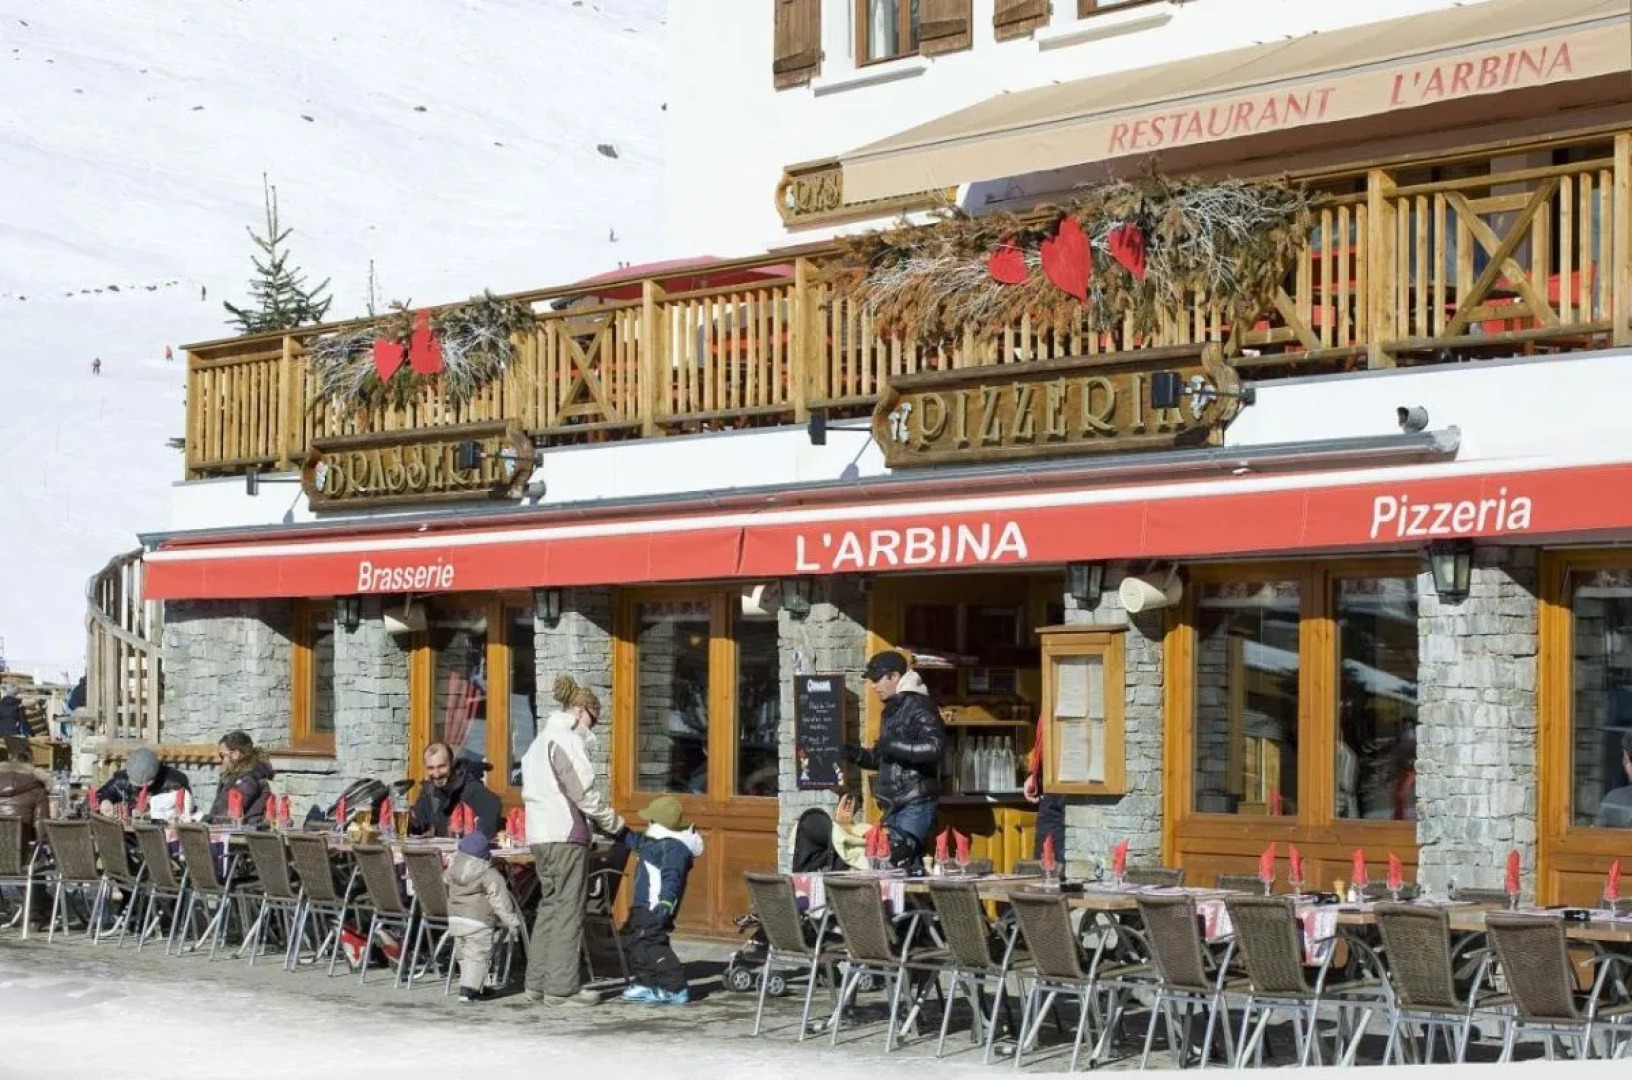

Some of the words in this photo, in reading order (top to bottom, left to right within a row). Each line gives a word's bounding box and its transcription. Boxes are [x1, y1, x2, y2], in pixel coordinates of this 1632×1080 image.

[1107, 86, 1337, 155] RESTAURANT
[1390, 41, 1574, 108] L'ARBINA
[1370, 486, 1533, 540] Pizzeria
[795, 520, 1029, 572] L'ARBINA
[357, 556, 456, 592] Brasserie
